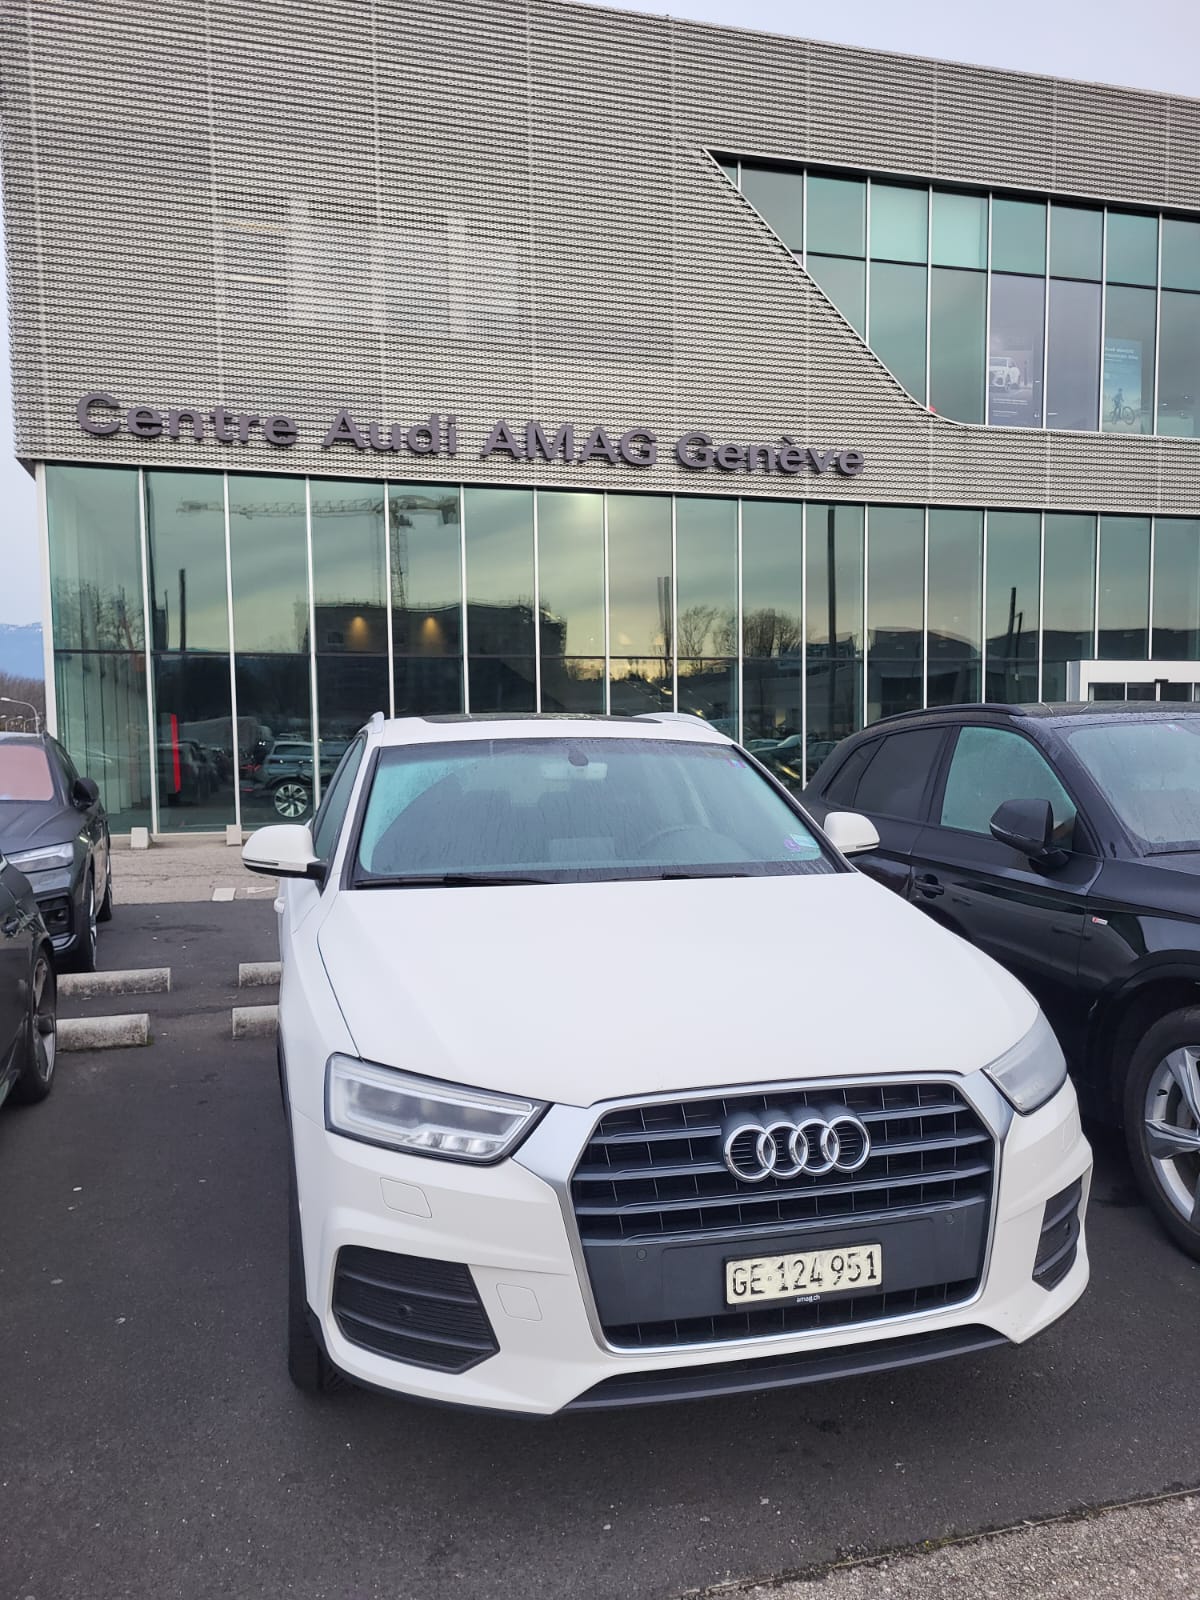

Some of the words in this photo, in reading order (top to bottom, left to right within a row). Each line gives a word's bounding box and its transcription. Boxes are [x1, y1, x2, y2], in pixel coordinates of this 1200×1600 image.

[76, 391, 298, 446] Centre
[322, 407, 457, 456] Audi
[480, 419, 657, 466] AMAG
[676, 431, 865, 476] Genève
